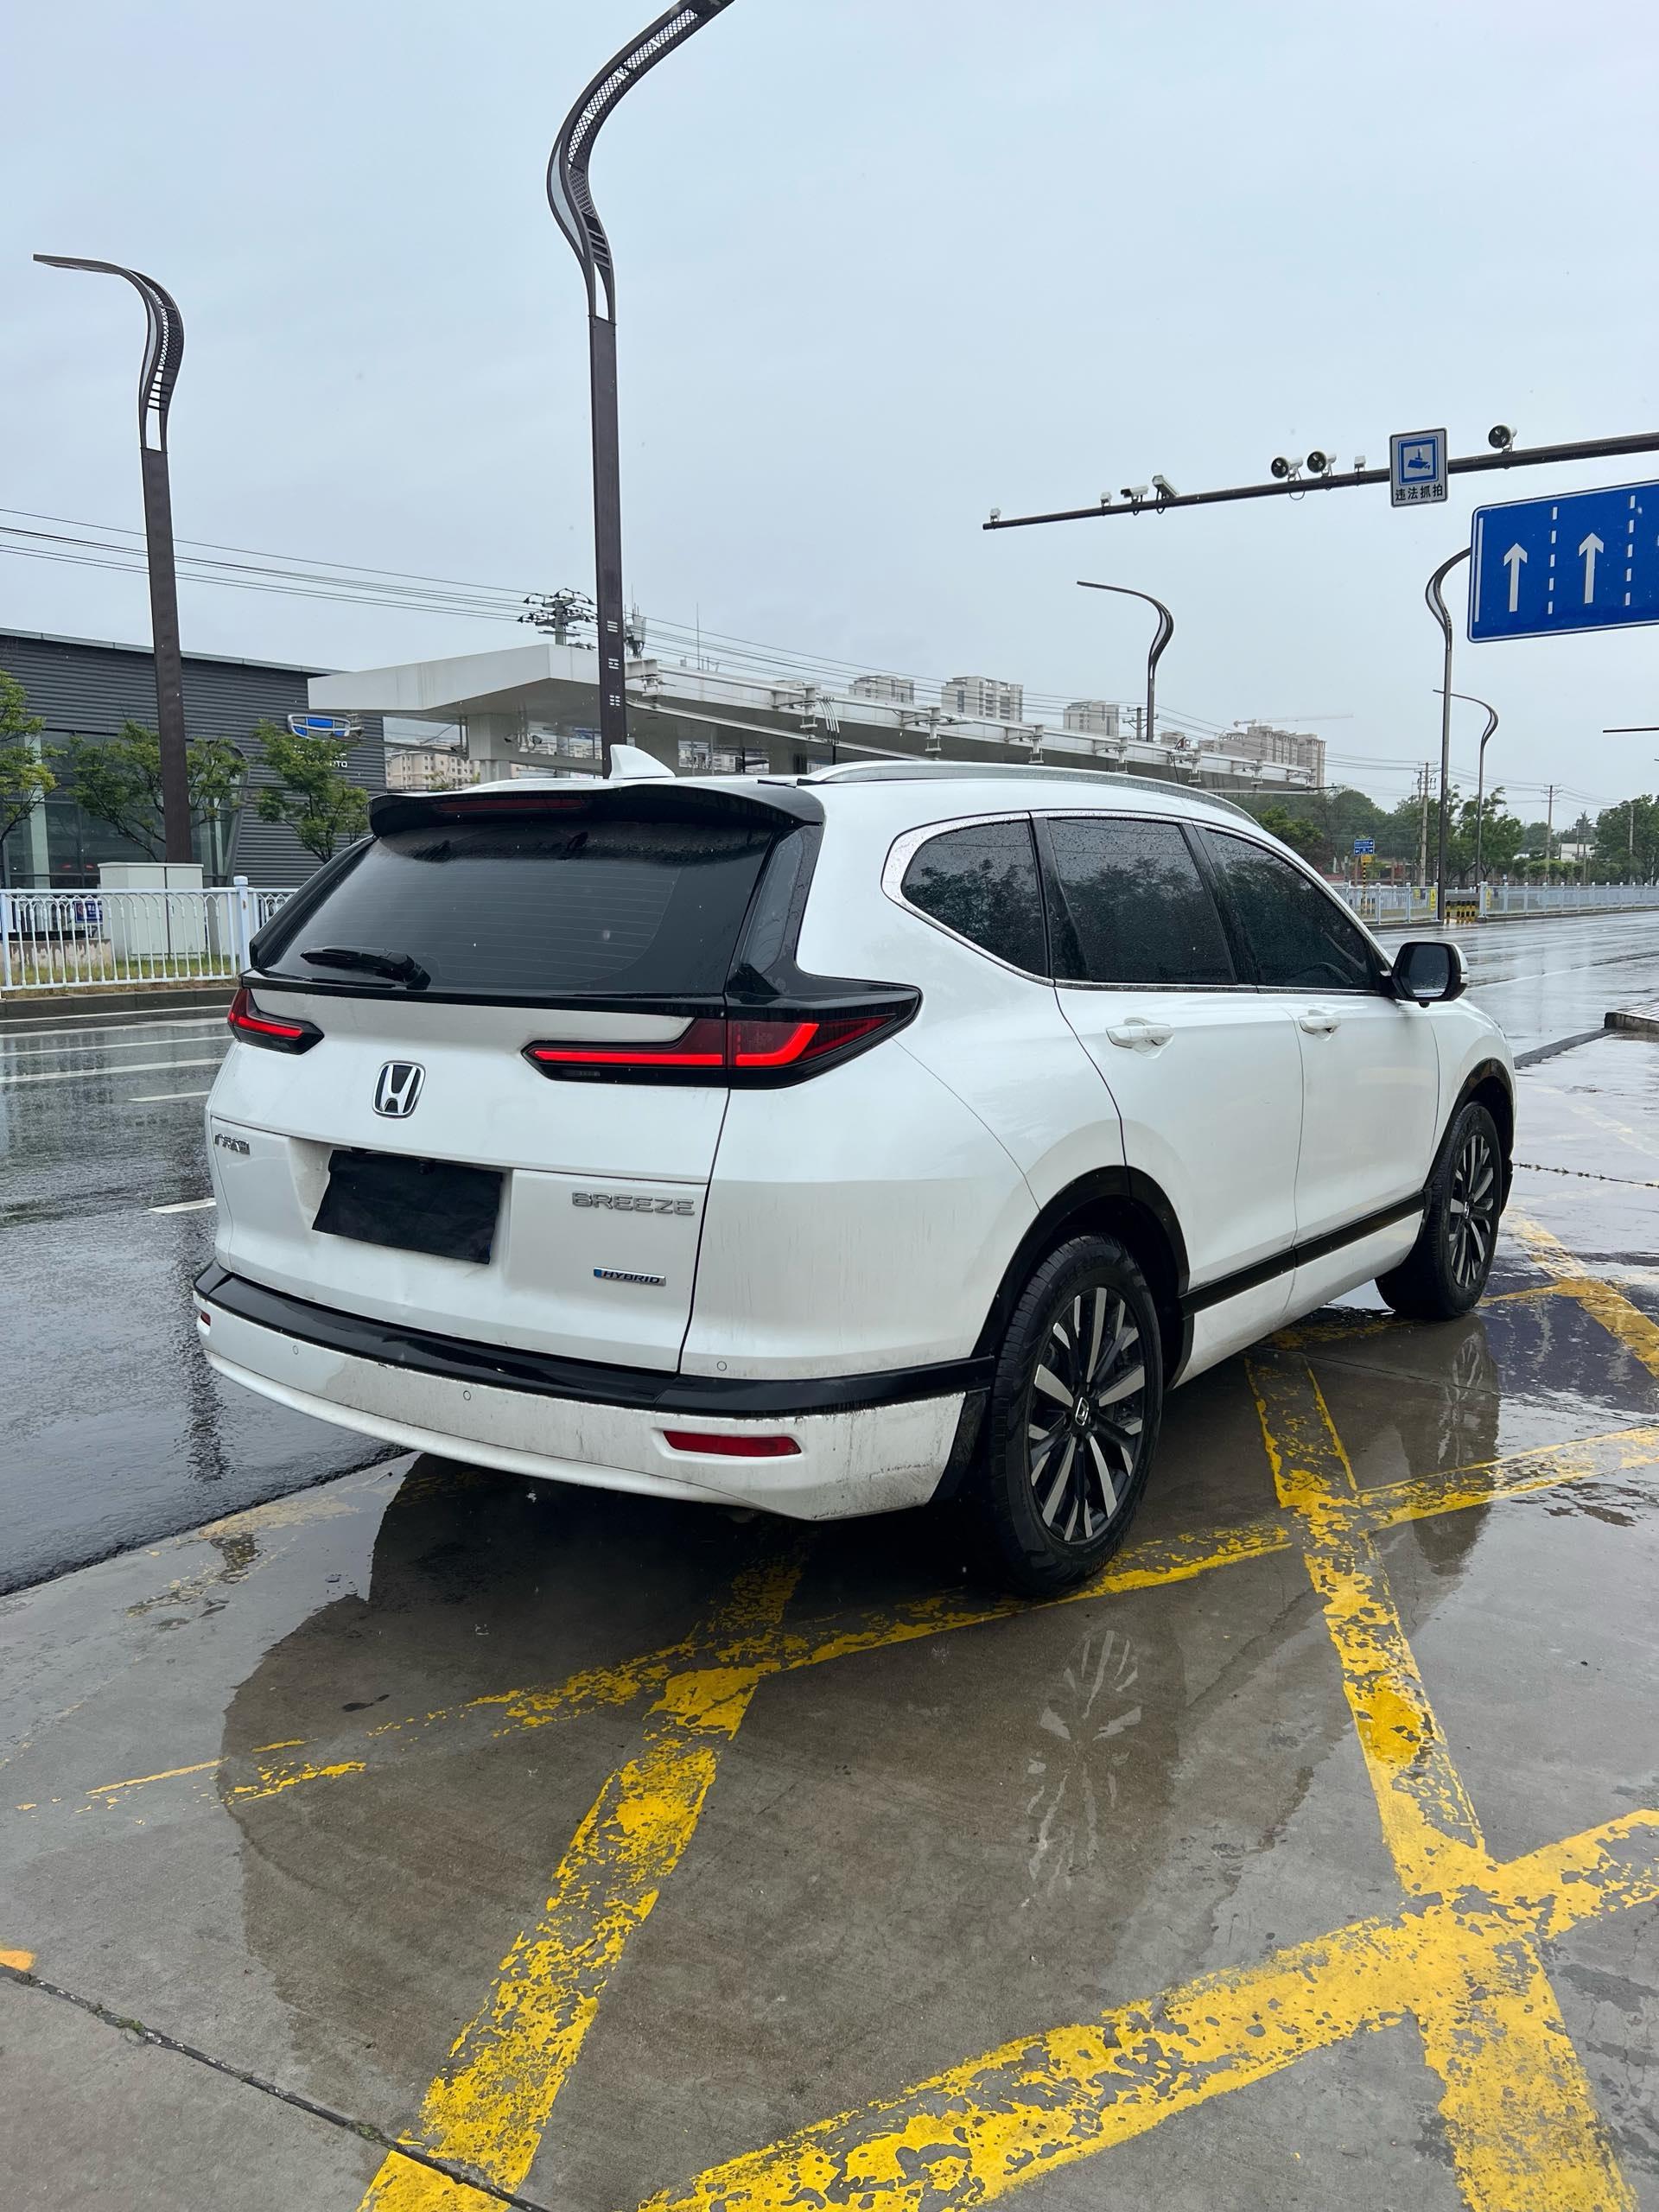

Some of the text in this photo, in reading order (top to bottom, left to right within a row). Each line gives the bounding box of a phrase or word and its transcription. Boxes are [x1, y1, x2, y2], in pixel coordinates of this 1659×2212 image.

[1395, 484, 1443, 501] 违法抓拍
[572, 1192, 695, 1216] BREEZE
[603, 1270, 660, 1284] HYBRID
